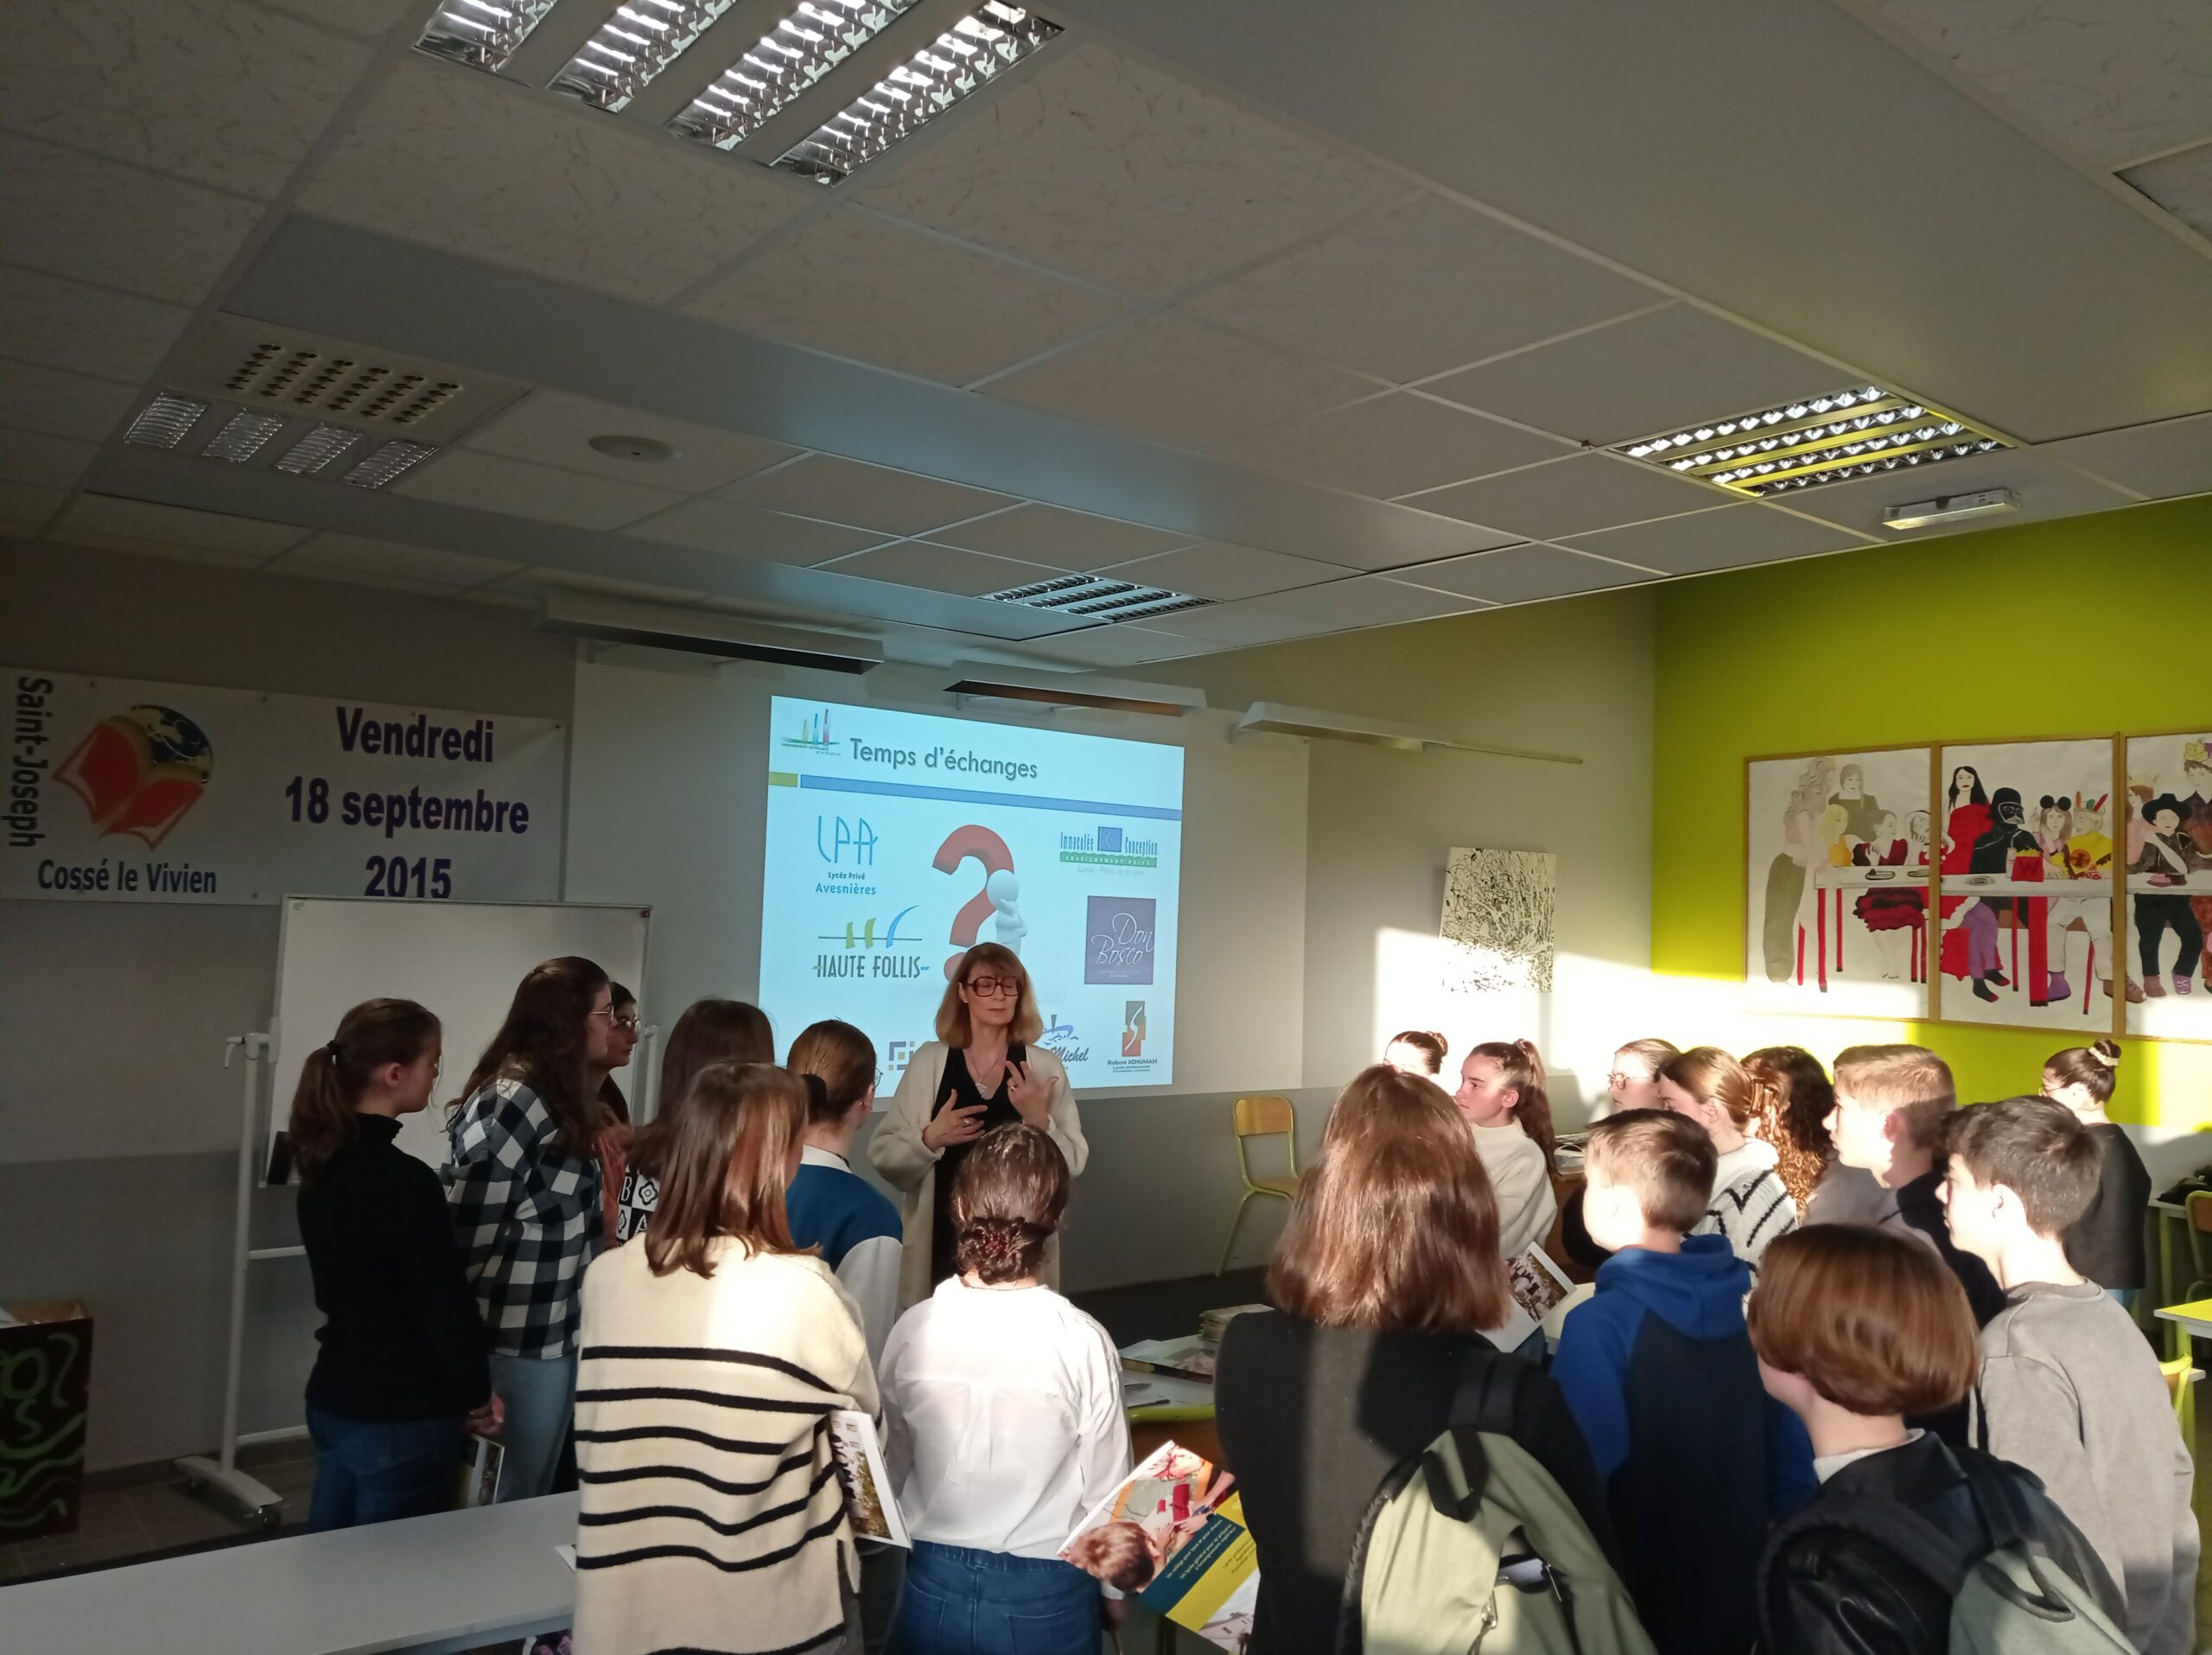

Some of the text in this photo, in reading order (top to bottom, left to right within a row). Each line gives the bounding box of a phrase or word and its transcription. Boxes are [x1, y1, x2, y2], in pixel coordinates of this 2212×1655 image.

[336, 706, 493, 762] Vendredi
[2, 676, 54, 848] Saint-Joseph
[850, 737, 1037, 780] Temps d'échanges
[285, 776, 529, 838] 18 septembre
[38, 858, 216, 894] Cossé le Vivien
[364, 856, 451, 899] 2015
[815, 882, 876, 894] Avesnières
[828, 871, 847, 880] Lycée
[1091, 934, 1143, 965] Bosco
[1112, 913, 1154, 952] Don
[817, 954, 921, 978] HAUTE FOLLIS
[1051, 1046, 1089, 1062] Michel
